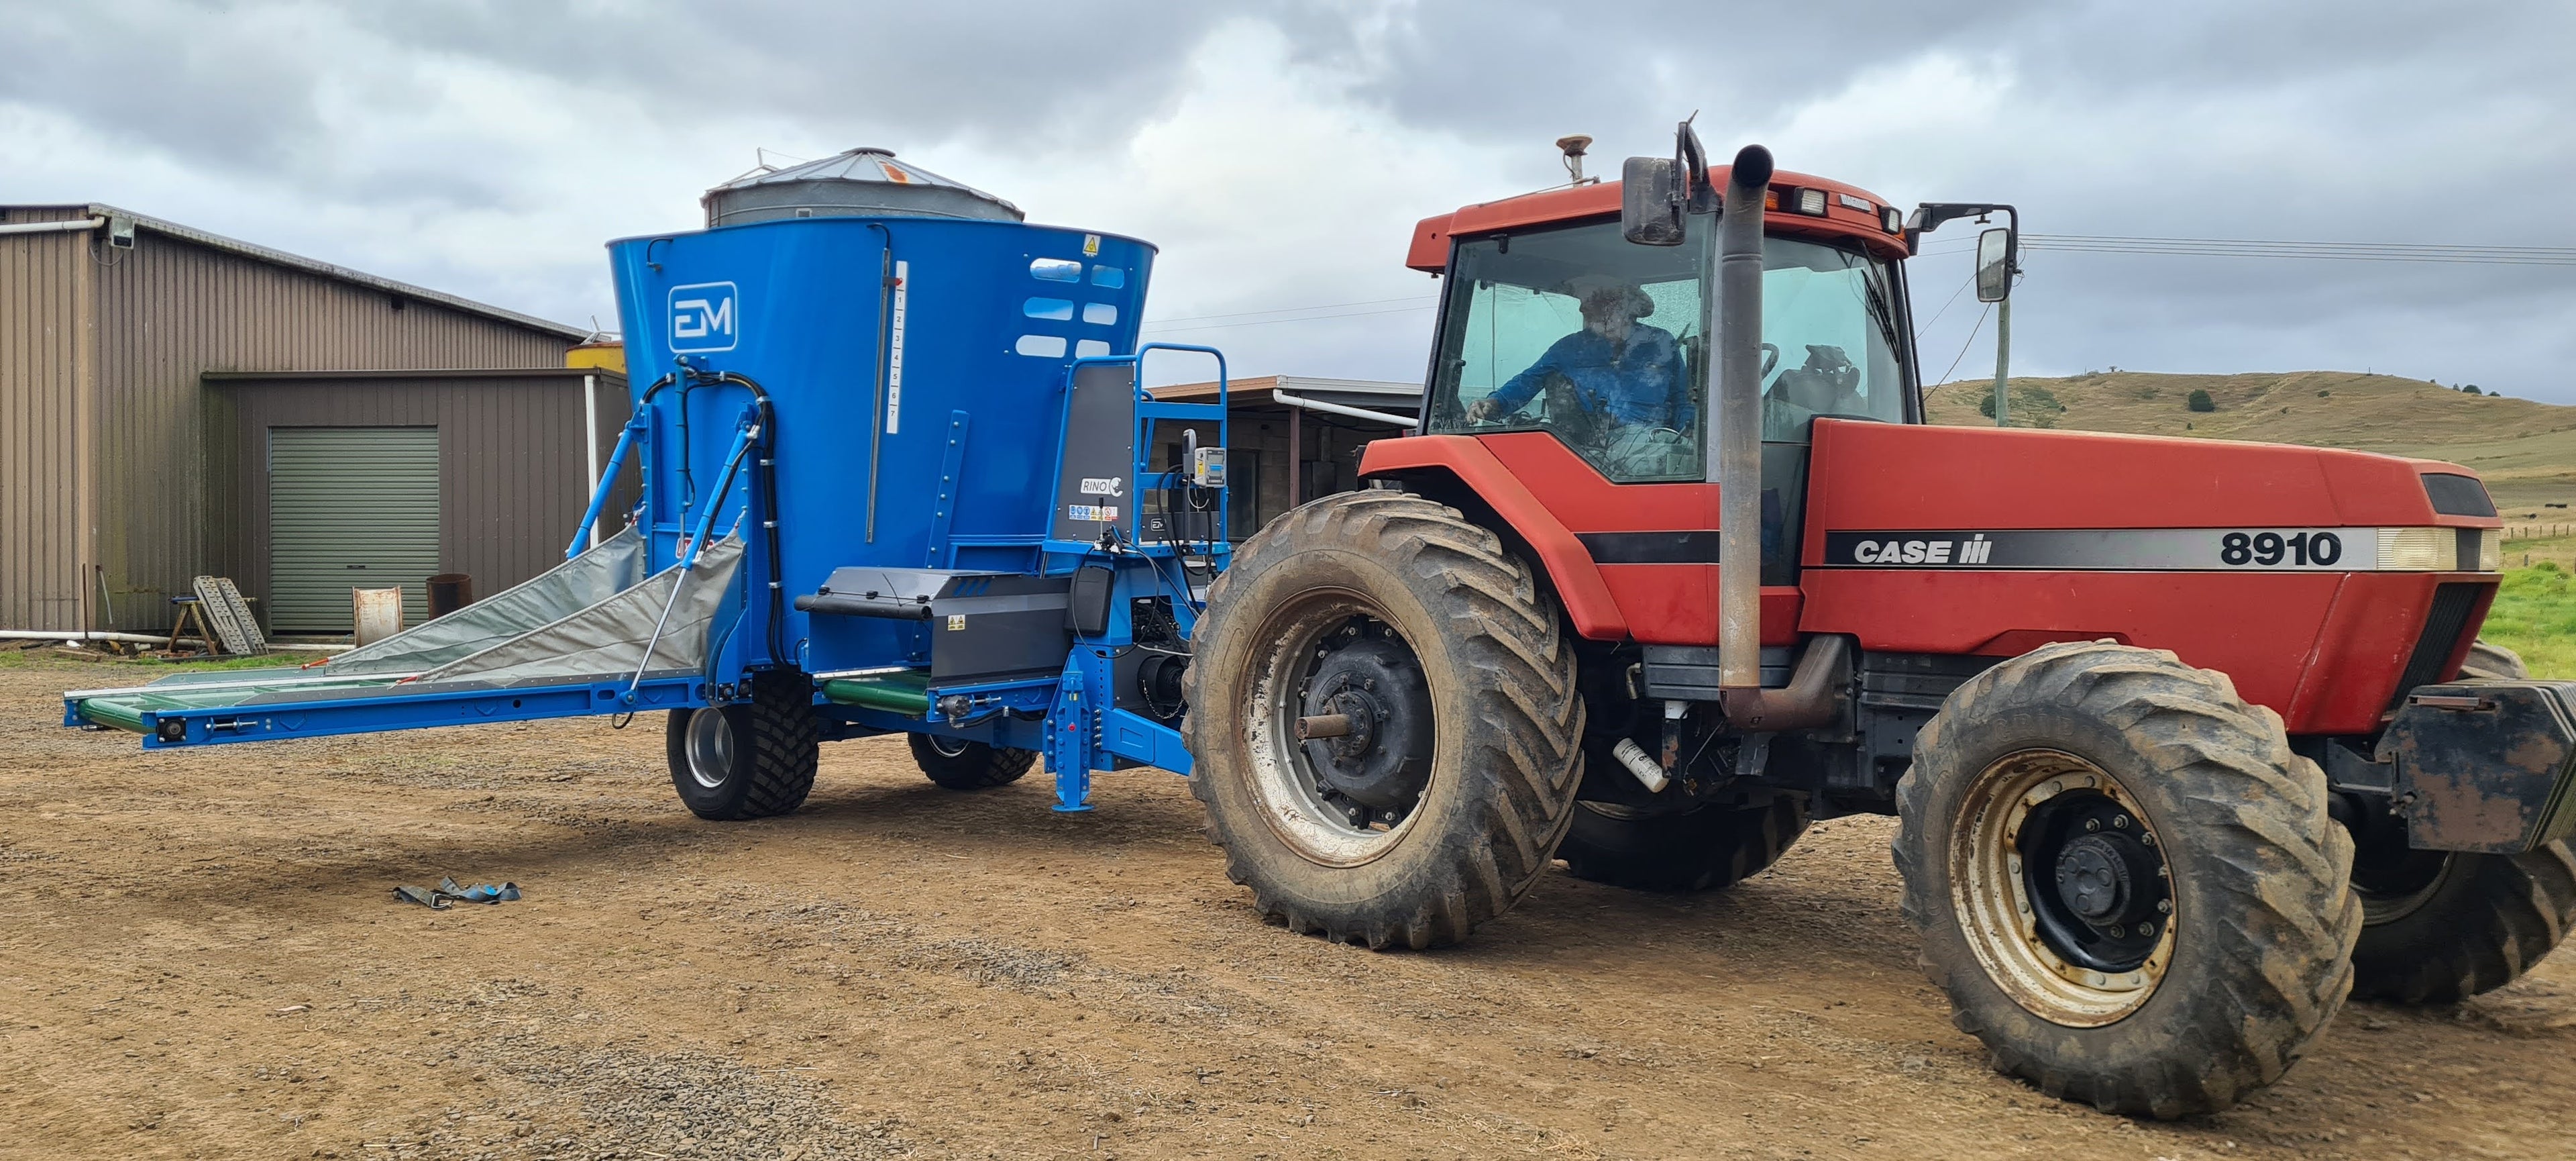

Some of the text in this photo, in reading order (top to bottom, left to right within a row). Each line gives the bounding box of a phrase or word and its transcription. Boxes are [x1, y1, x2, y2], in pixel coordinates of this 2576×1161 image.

[674, 297, 731, 338] EM
[1083, 481, 1107, 491] RINO
[1854, 540, 1953, 564] CASE
[2221, 532, 2343, 566] 8910
